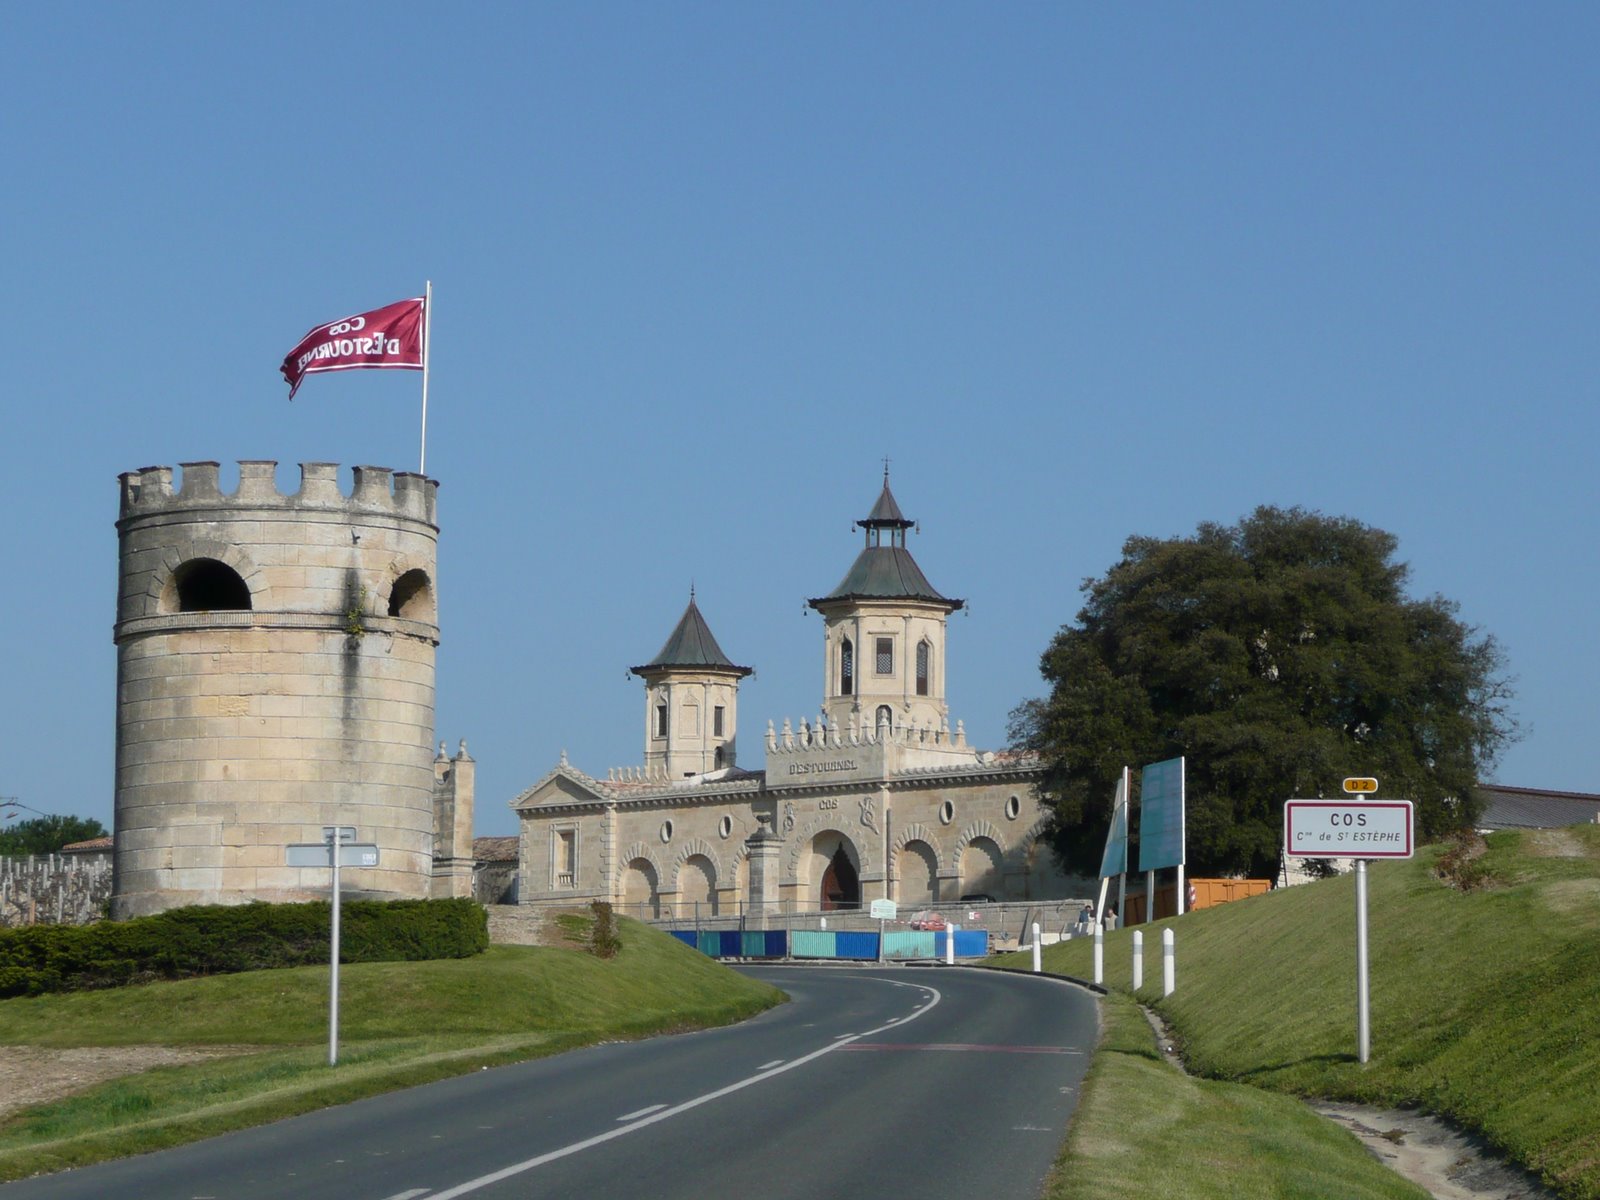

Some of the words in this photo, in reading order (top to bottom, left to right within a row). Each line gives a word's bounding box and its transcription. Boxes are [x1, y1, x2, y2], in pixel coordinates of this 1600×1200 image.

[1351, 781, 1358, 790] D
[1362, 781, 1369, 790] 2
[819, 798, 838, 810] COS
[1330, 813, 1367, 826] COS
[1319, 831, 1331, 841] de
[1353, 830, 1401, 841] ESTÈPHE
